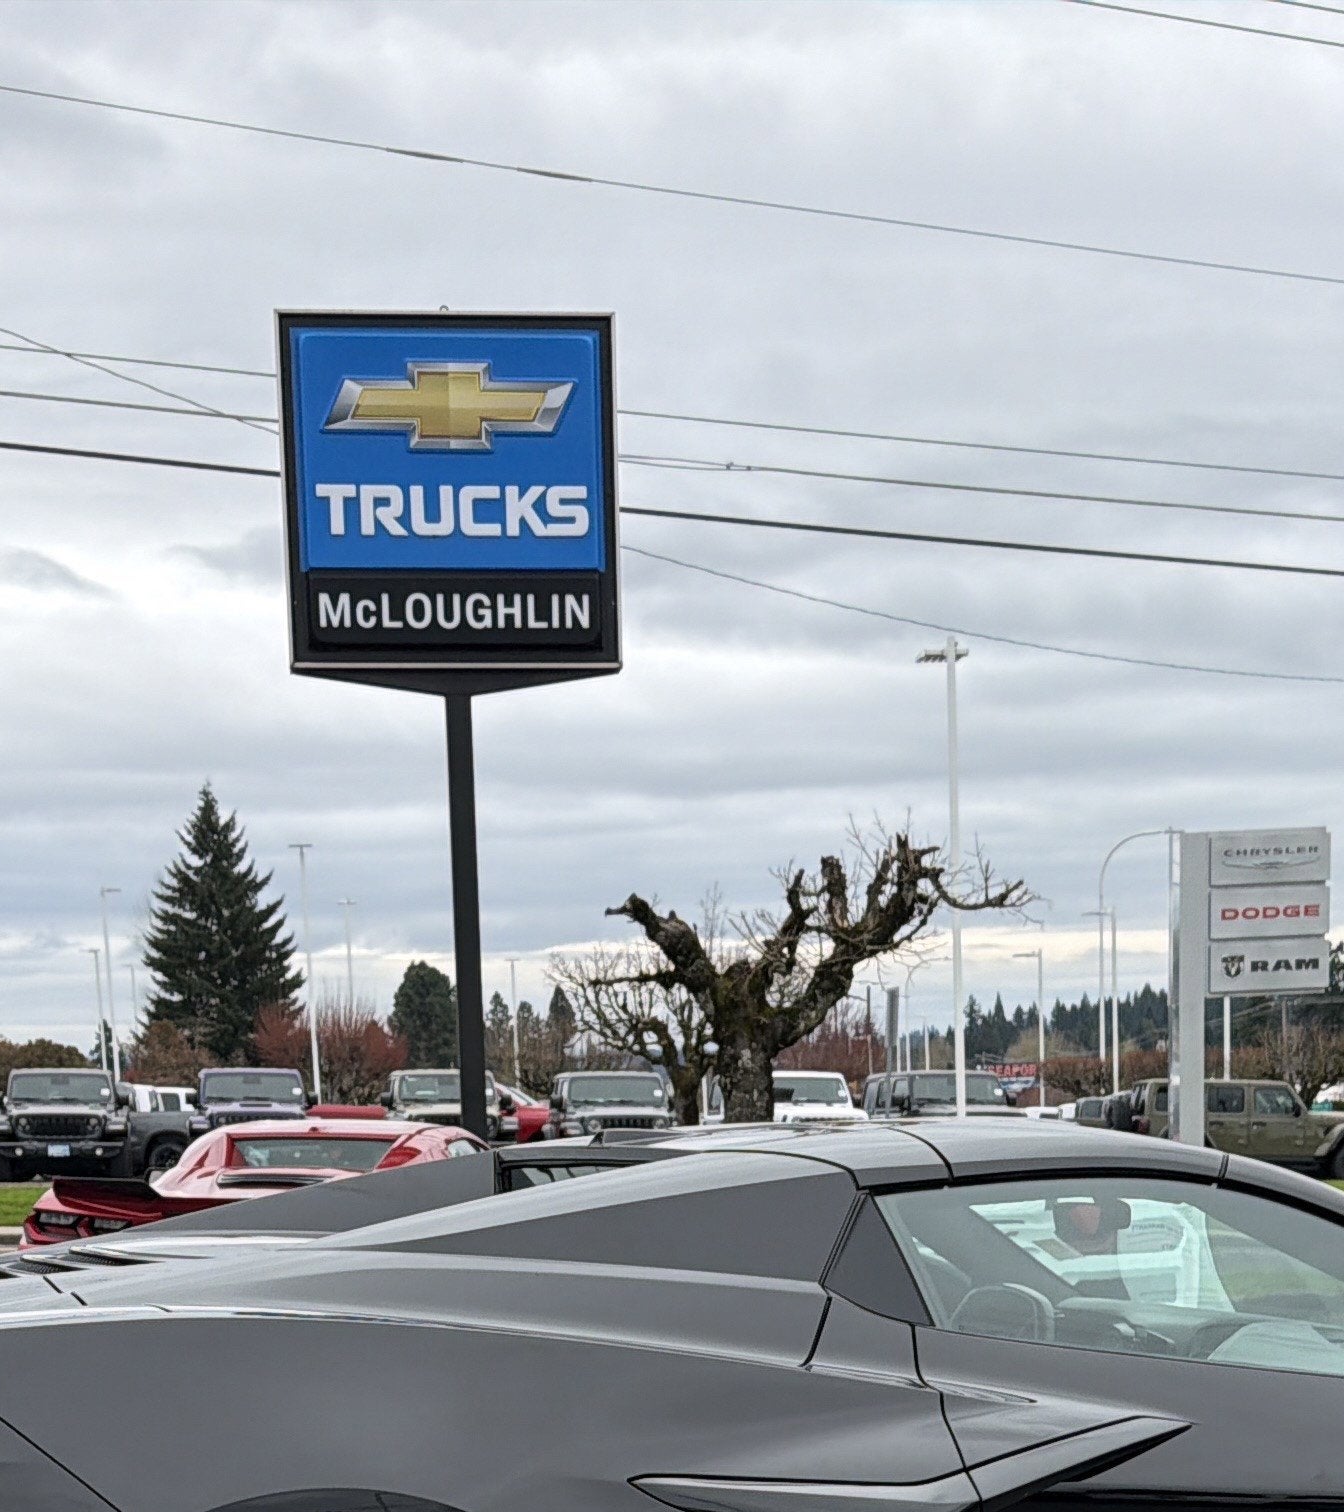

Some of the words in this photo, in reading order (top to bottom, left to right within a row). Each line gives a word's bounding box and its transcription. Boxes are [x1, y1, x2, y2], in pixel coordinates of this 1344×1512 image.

[315, 483, 590, 537] TRUCKS
[318, 592, 591, 630] McLOUGHLIN
[1223, 845, 1319, 858] CHRYSLER
[1220, 903, 1320, 921] DODGE
[1250, 957, 1320, 972] RAM
